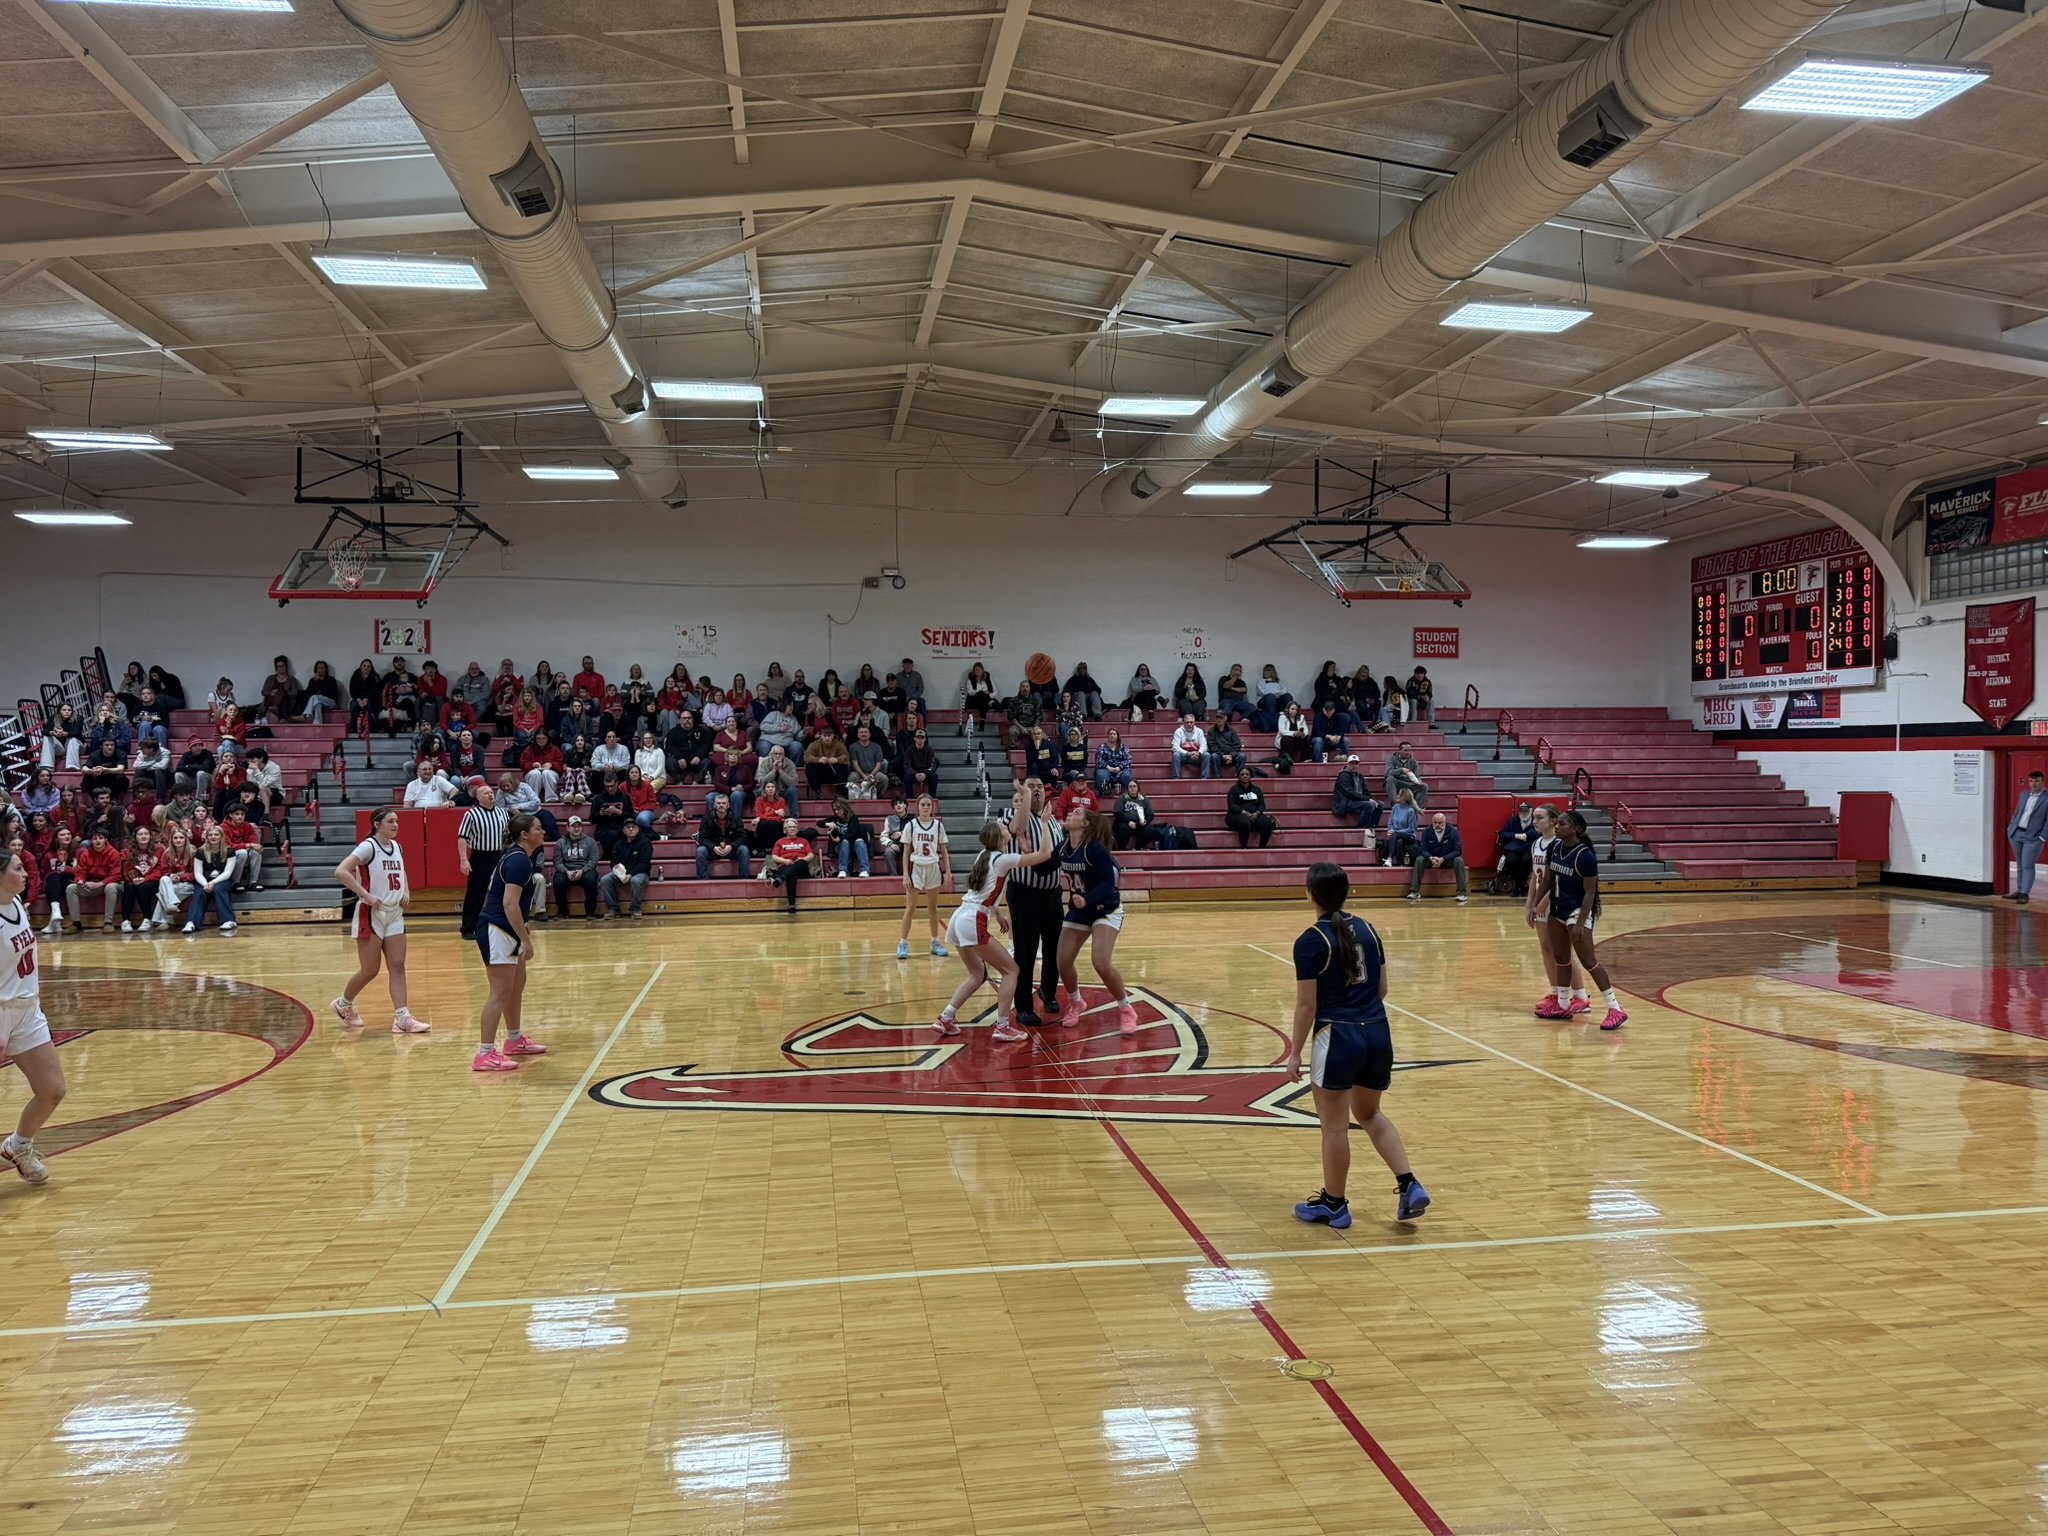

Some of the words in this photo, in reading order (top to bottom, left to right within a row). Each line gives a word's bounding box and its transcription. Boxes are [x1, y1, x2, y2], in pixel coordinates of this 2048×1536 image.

[1930, 490, 1992, 515] MAVERICK
[1697, 551, 1737, 579] HOME
[1737, 546, 1758, 571] OF
[1759, 540, 1790, 566] THE
[1762, 567, 1797, 594] 8:00
[1845, 570, 1853, 584] 0
[1863, 567, 1871, 581] 0
[1705, 594, 1712, 607] 0
[1719, 592, 1726, 605] 0
[1795, 591, 1821, 605] GUEST
[1836, 588, 1843, 602] 3
[1845, 586, 1853, 600] 0
[1863, 583, 1871, 598] 0
[1729, 600, 1759, 614] FALCONS
[1765, 602, 1783, 611] PERIOD
[1832, 604, 1843, 618] 12
[1845, 602, 1853, 617] 0
[1863, 600, 1871, 614] 0
[1698, 610, 1704, 623] 3
[1705, 609, 1712, 621] 0
[1719, 607, 1726, 619] 0
[1810, 605, 1821, 629] 0
[1697, 624, 1704, 637] 5
[1705, 623, 1712, 636] 0
[1719, 622, 1726, 634] 0
[1744, 615, 1754, 637] 0
[1828, 621, 1843, 635] 21
[1845, 619, 1853, 633] 0
[1863, 617, 1871, 631] 0
[1988, 626, 2009, 637] LEAGUE
[921, 628, 995, 650] SENIORS!
[1415, 631, 1457, 642] STUDENT
[1760, 636, 1777, 645] PLAYER
[1778, 635, 1790, 644] FOUL
[1805, 630, 1823, 640] FOULS
[1828, 637, 1843, 651] 24
[1845, 635, 1853, 649] 0
[1863, 633, 1871, 648] 0
[1415, 643, 1456, 654] SECTION
[1705, 637, 1712, 650] 0
[1719, 636, 1726, 648] 0
[1729, 640, 1745, 650] FOULS
[1811, 640, 1820, 658] 0
[1695, 652, 1704, 665] 15
[1705, 652, 1712, 664] 0
[1719, 650, 1725, 662] 0
[1735, 649, 1742, 666] 0
[1845, 652, 1853, 666] 0
[1705, 665, 1712, 678] 0
[1730, 668, 1745, 678] SCORE
[1765, 665, 1783, 675] MATCH
[1805, 661, 1823, 671] SCORE
[1718, 681, 1748, 691] Scoreboards
[1749, 679, 1769, 688] donated
[1770, 679, 1777, 688] by
[1778, 679, 1787, 687] the
[1788, 676, 1813, 686] Brimfield
[1814, 672, 1839, 686] meijer
[1713, 697, 1736, 712] BIG
[1988, 698, 2007, 709] STATE
[1713, 712, 1736, 725] RED
[922, 843, 930, 857] 5
[387, 873, 401, 891] 15
[1554, 874, 1560, 898] 1
